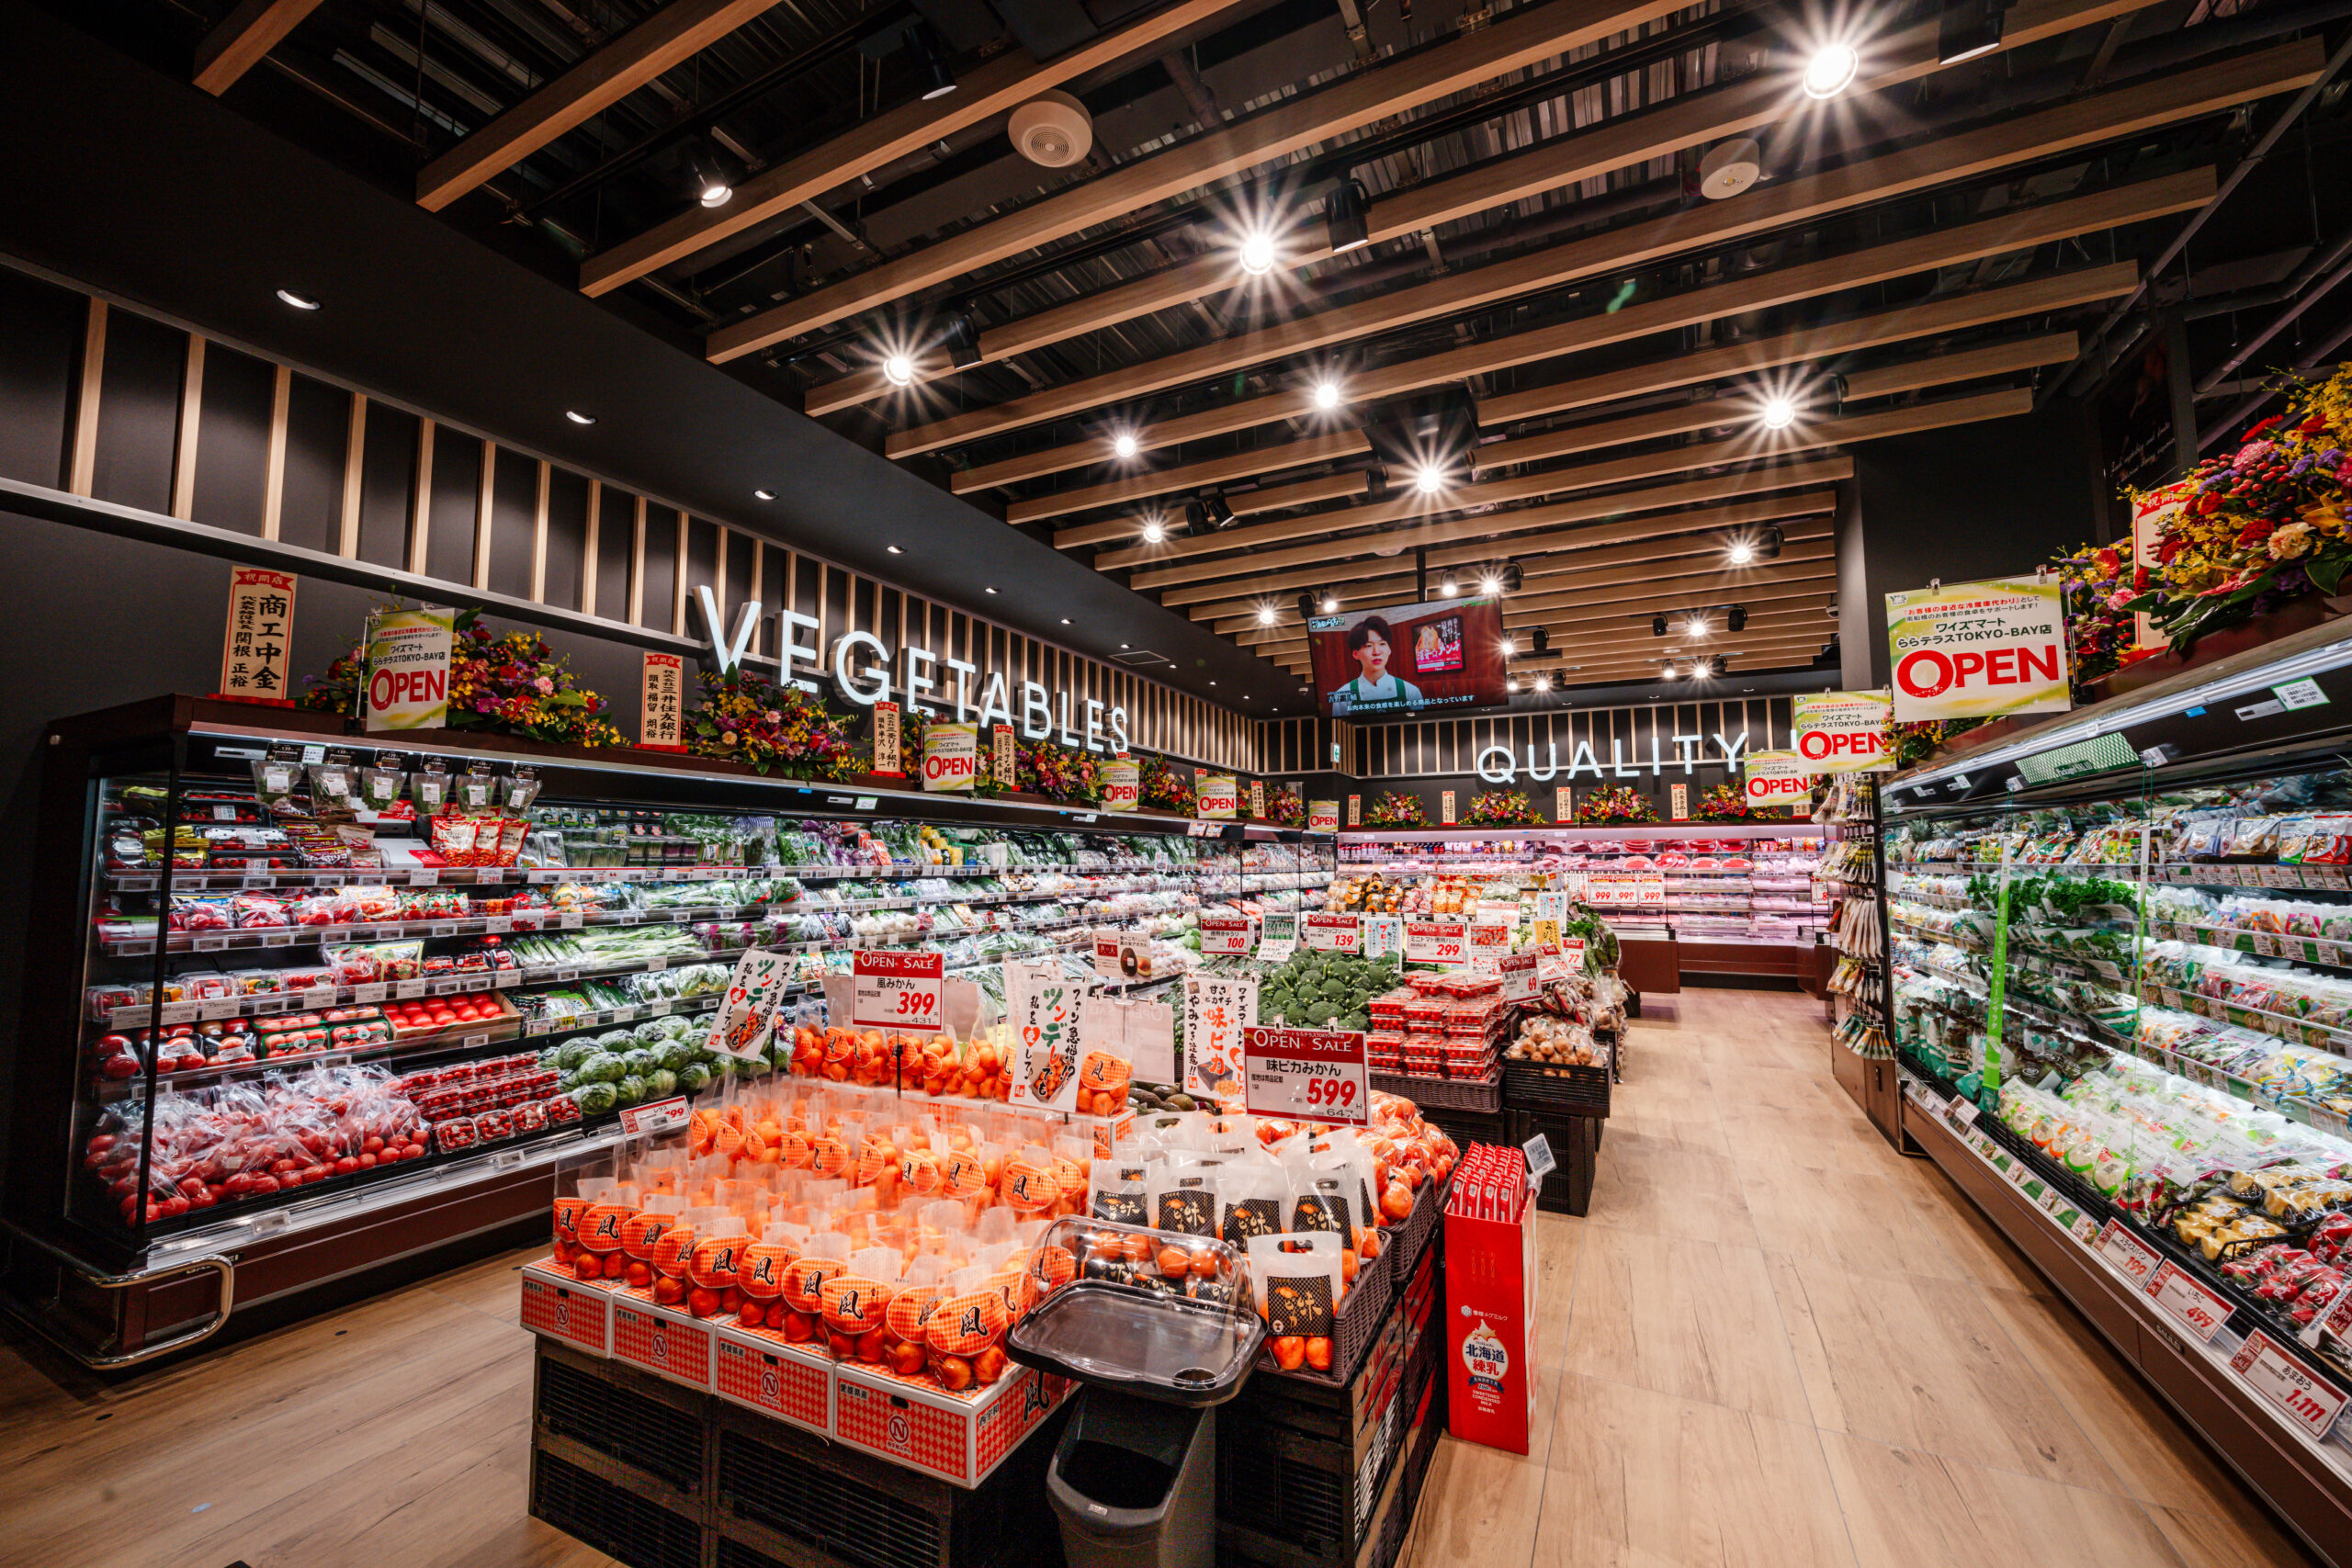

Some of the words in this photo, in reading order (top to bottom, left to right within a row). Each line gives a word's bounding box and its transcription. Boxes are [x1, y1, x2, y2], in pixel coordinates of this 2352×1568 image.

[244, 571, 284, 584] 祝開店
[1936, 617, 2007, 633] ワイズマート
[251, 593, 288, 691] 商工中金
[1898, 625, 2052, 649] ららテラスTOKYO-BAY店
[390, 643, 424, 654] ワイズマート
[373, 651, 446, 666] ららテラスTOKYO-BAY店
[692, 584, 1128, 754] VEGETABLES
[1897, 645, 2059, 698] OPEN
[370, 668, 446, 711] OPEN
[1800, 730, 1892, 761] OPEN
[1477, 731, 1749, 784] QUALITY
[925, 755, 973, 780] OPEN
[1103, 784, 1137, 802] OPEN
[1748, 777, 1808, 797] OPEN
[1199, 795, 1235, 811] OPEN
[1310, 815, 1338, 826] OPEN
[1645, 892, 1660, 900] 999
[1412, 923, 1435, 932] OPEN
[1227, 938, 1245, 948] 100
[1335, 934, 1353, 946] 139
[1436, 944, 1460, 955] 299
[861, 952, 895, 968] OPEN
[903, 958, 933, 969] SALE
[1501, 958, 1521, 967] OPEN
[1568, 954, 1580, 964] 77
[746, 959, 775, 1022] ツンデレ
[877, 977, 915, 989] 風みかん
[1209, 985, 1227, 995] 甘さ
[1528, 976, 1537, 991] 69
[897, 992, 934, 1015] 399
[731, 1022, 747, 1046] でも
[1041, 987, 1068, 1066] ツンデレ
[1207, 1005, 1227, 1076] 味ピカ
[1254, 1029, 1300, 1049] OPEN
[1312, 1038, 1352, 1053] SALE
[1266, 1059, 1341, 1077] 味ピカみかん
[1038, 1067, 1053, 1096] でも
[1306, 1078, 1356, 1107] 599
[1327, 1109, 1353, 1118] 647
[2120, 1236, 2147, 1260] スライスパイン
[2125, 1256, 2147, 1276] 199
[2188, 1287, 2204, 1303] いちご
[839, 1290, 865, 1320] 風
[960, 1306, 988, 1337] 風
[2187, 1307, 2215, 1327] 499
[1465, 1343, 1505, 1363] 北海道
[1473, 1359, 1499, 1376] 練乳
[2282, 1366, 2312, 1391] あまおう
[840, 1382, 868, 1401] 愛媛県産
[1472, 1389, 1500, 1400] SWEETENED
[1472, 1393, 1501, 1404] CONDENSED
[2285, 1389, 2326, 1423] 1,111
